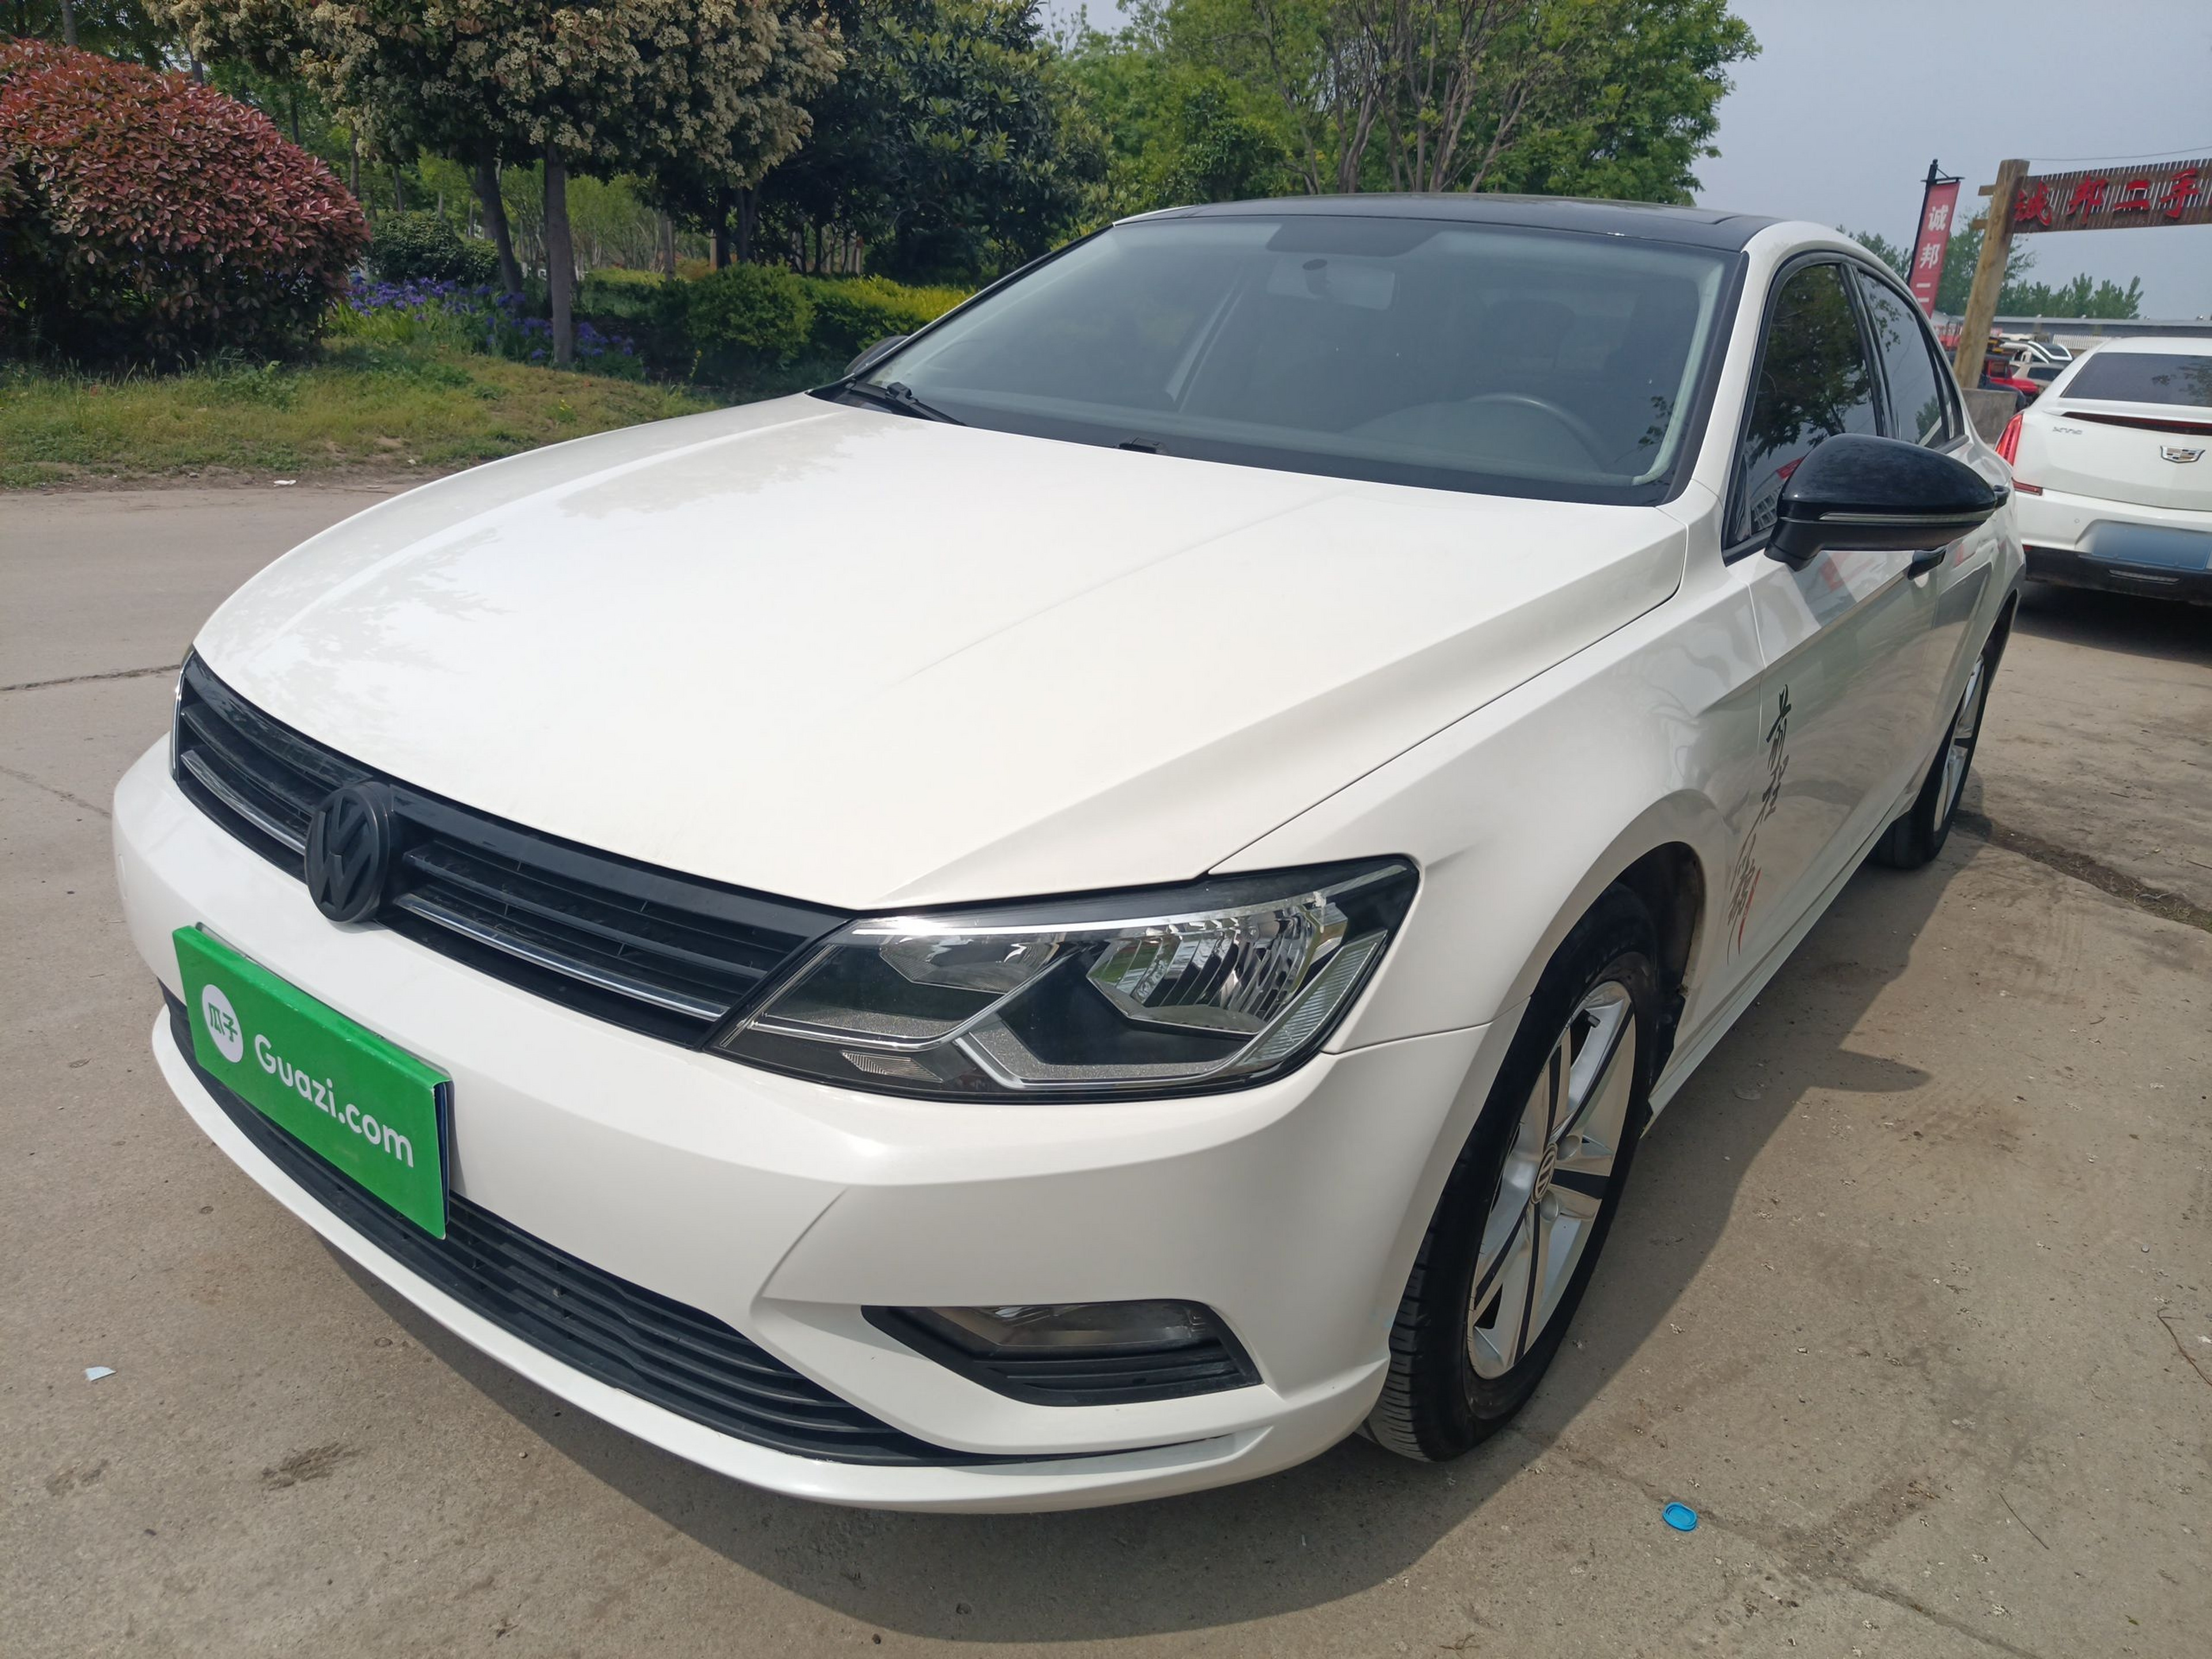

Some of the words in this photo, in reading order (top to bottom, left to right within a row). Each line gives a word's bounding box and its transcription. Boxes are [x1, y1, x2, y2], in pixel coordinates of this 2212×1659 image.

[2014, 167, 2212, 226] 诚邦二手
[1916, 204, 1949, 302] 诚邦二
[255, 1034, 414, 1168] Guazi.com
